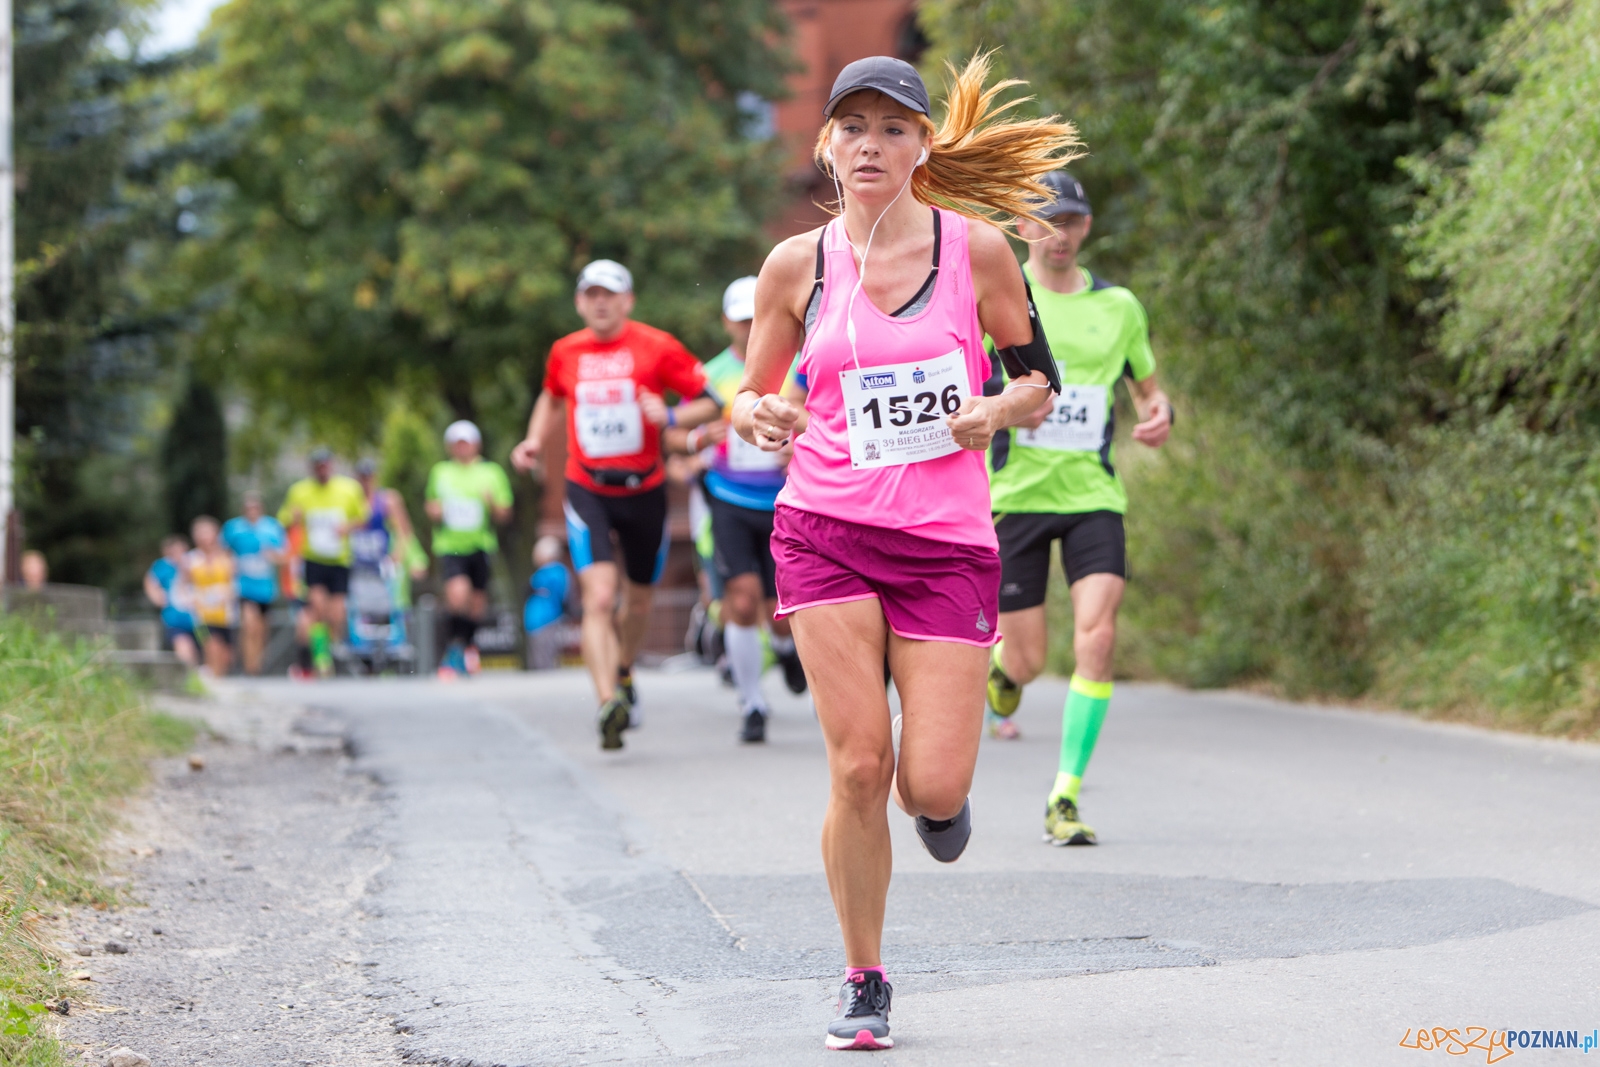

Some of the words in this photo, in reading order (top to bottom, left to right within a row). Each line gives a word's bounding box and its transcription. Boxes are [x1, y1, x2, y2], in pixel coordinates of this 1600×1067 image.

[927, 370, 940, 378] Bank
[863, 384, 961, 430] 1526
[1043, 405, 1087, 424] 54
[882, 438, 895, 448] 39
[897, 435, 921, 446] BIEG
[923, 428, 952, 442] LECHI
[898, 425, 935, 436] MAŁGORZATA
